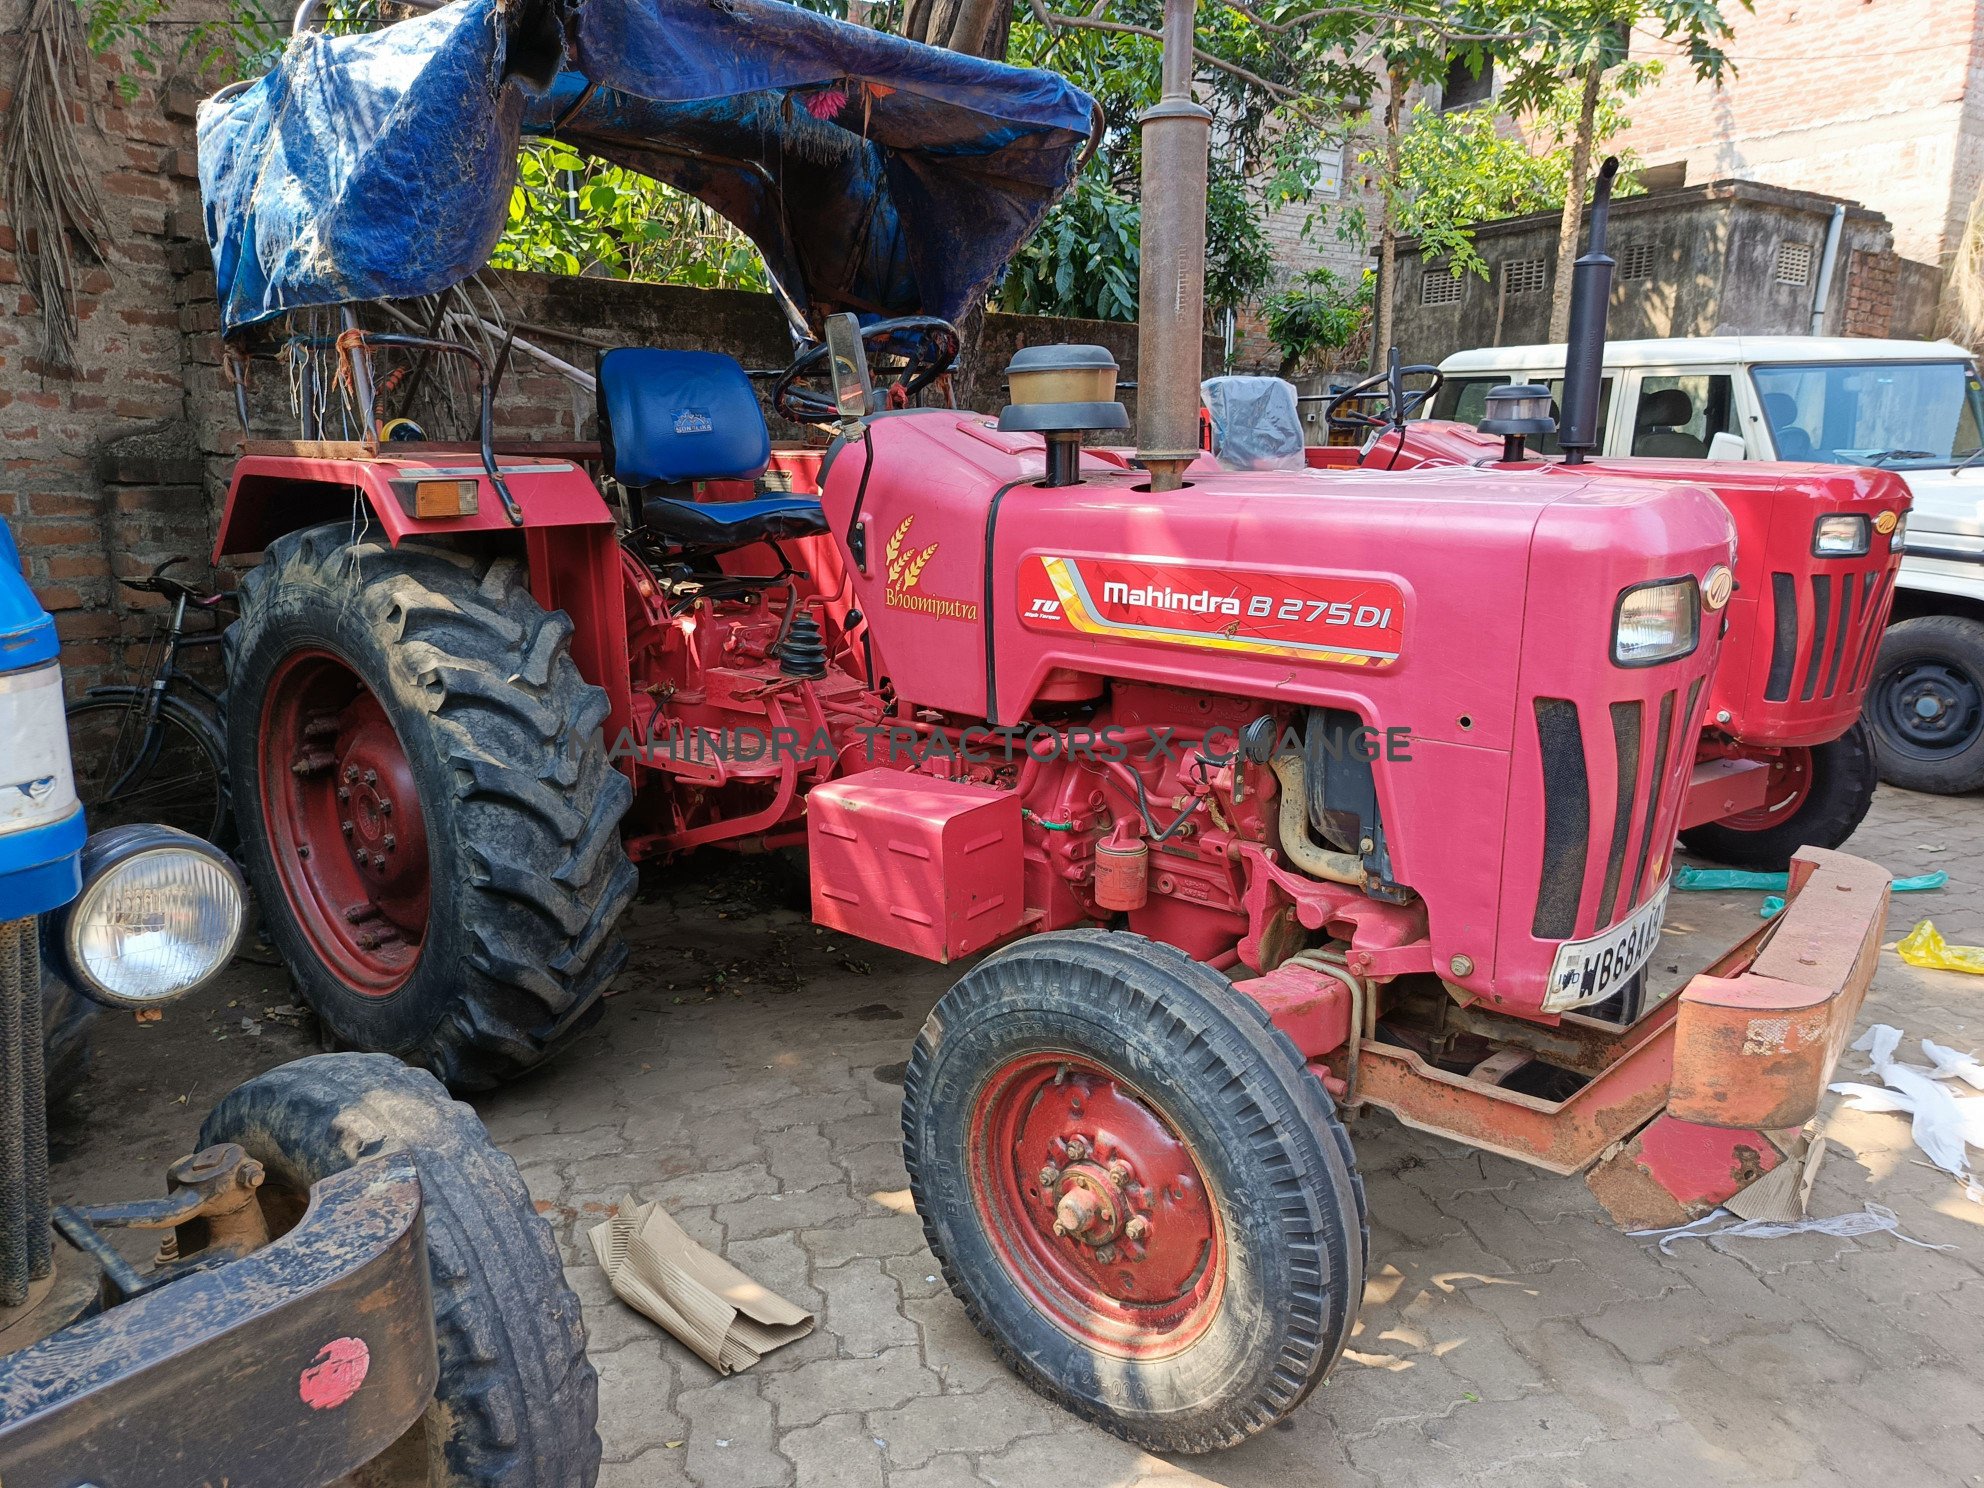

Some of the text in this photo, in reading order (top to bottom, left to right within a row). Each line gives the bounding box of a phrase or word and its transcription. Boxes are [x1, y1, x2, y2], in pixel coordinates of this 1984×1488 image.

[885, 587, 978, 621] Bhoomiputra
[1031, 598, 1060, 613] TU
[1103, 581, 1240, 615] Mahindra
[1247, 595, 1273, 617] B
[933, 1158, 964, 1219] BKT
